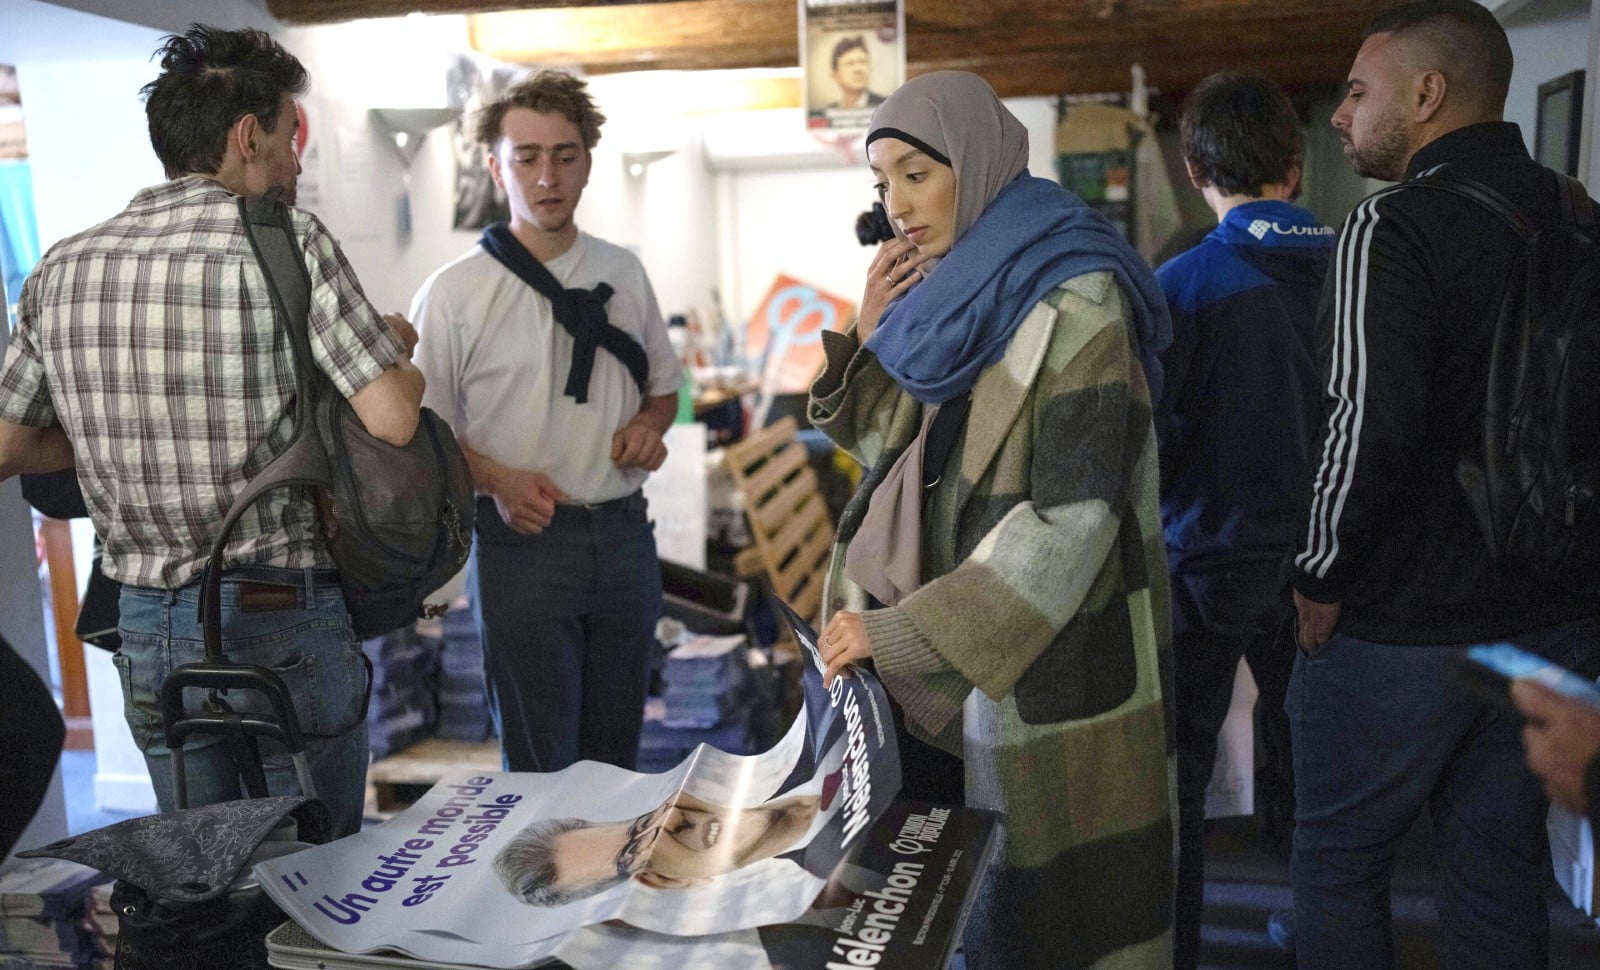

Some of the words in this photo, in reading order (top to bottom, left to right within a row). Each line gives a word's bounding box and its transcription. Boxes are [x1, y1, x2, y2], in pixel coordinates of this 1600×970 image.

[841, 687, 871, 849] Mélenchon
[313, 893, 379, 925] Un
[361, 838, 434, 892] autre
[418, 776, 493, 835] monde
[402, 874, 452, 907] est
[436, 794, 523, 868] possible
[917, 807, 951, 843] POPULAIRE
[825, 862, 925, 970] élenchon
[834, 898, 866, 936] Jean-Luc
